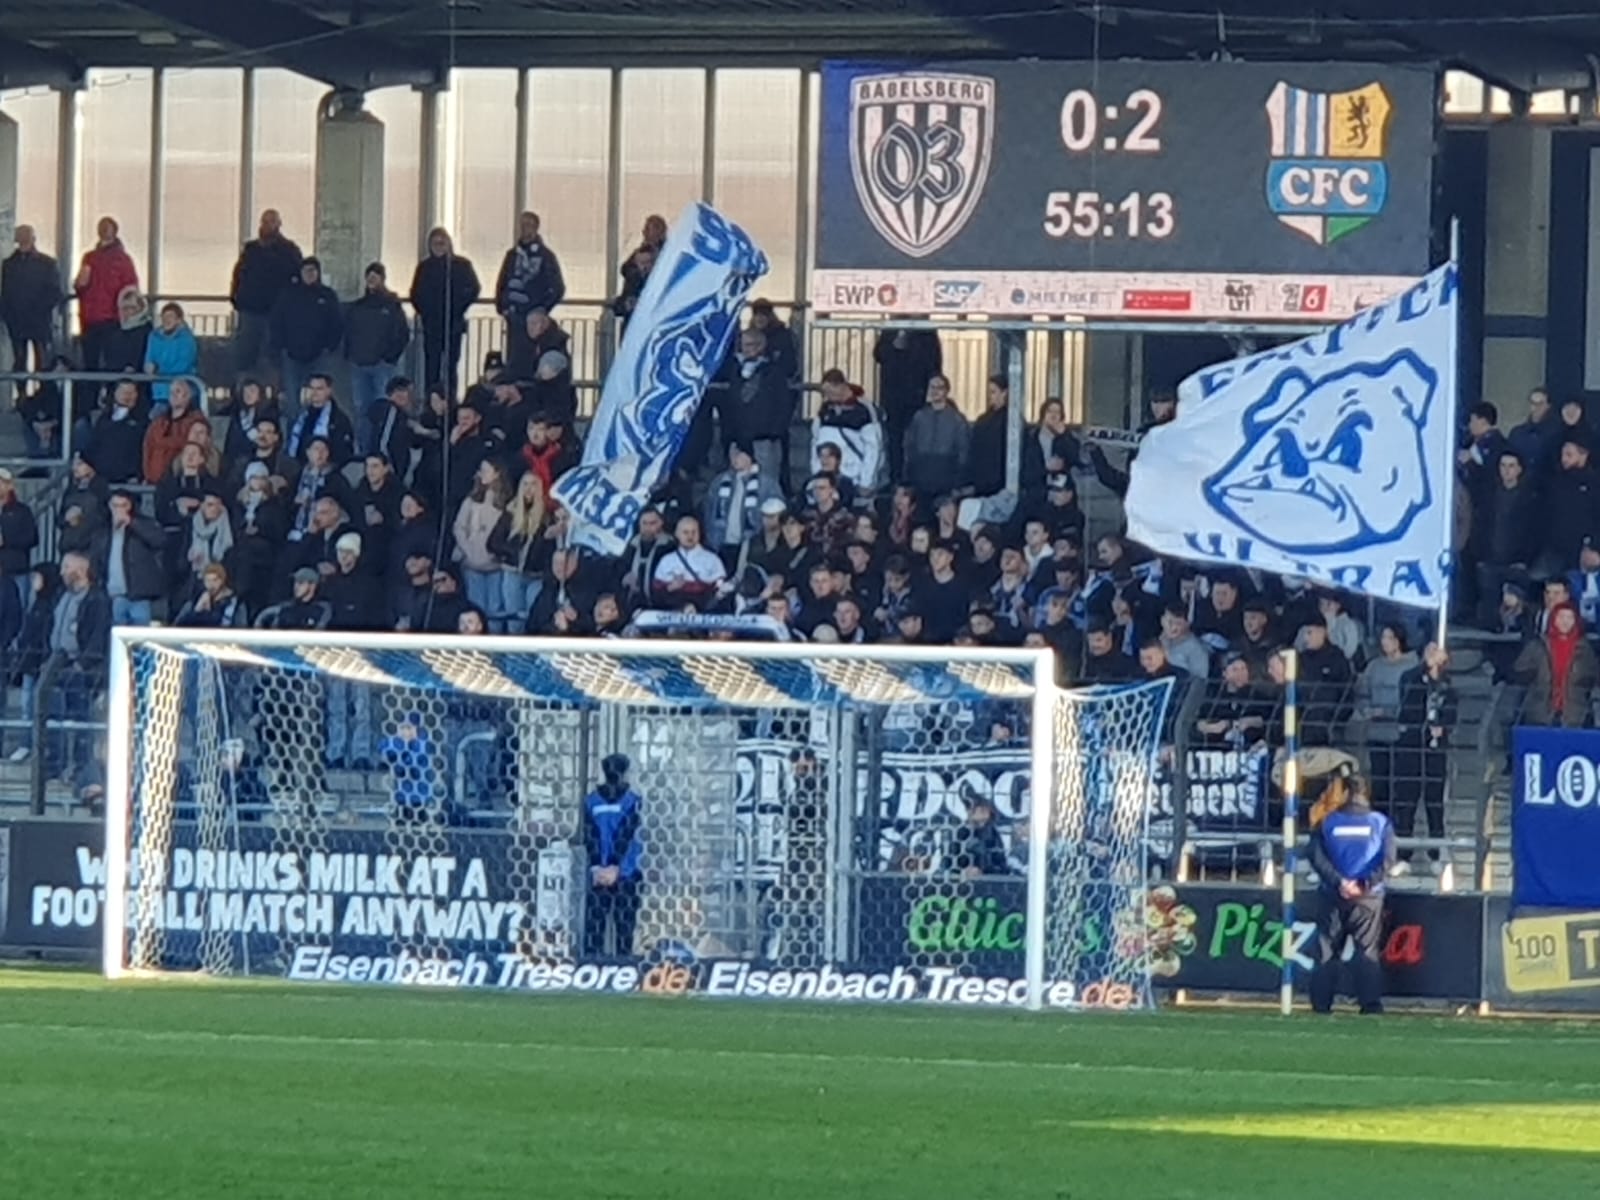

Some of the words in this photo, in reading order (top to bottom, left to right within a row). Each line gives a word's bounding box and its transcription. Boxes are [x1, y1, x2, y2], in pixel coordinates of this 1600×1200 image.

[859, 80, 985, 101] BABELSBERG
[1060, 88, 1162, 151] 0:2
[871, 120, 966, 204] 03
[1279, 166, 1370, 207] CFC
[1043, 191, 1174, 238] 55:13
[834, 285, 876, 306] EWP
[1523, 752, 1600, 808] LO
[173, 847, 301, 892] DRINKS
[309, 852, 402, 894] MILK
[406, 855, 456, 897] AT
[460, 857, 489, 899] A
[31, 884, 203, 929] FOOBALL
[210, 891, 334, 936] MATCH
[340, 896, 527, 943] ANYWAY?
[1208, 902, 1425, 971] Pizza
[288, 946, 488, 986] Eisenbach
[1514, 933, 1557, 960] 100
[706, 960, 916, 1000] Eisenbach
